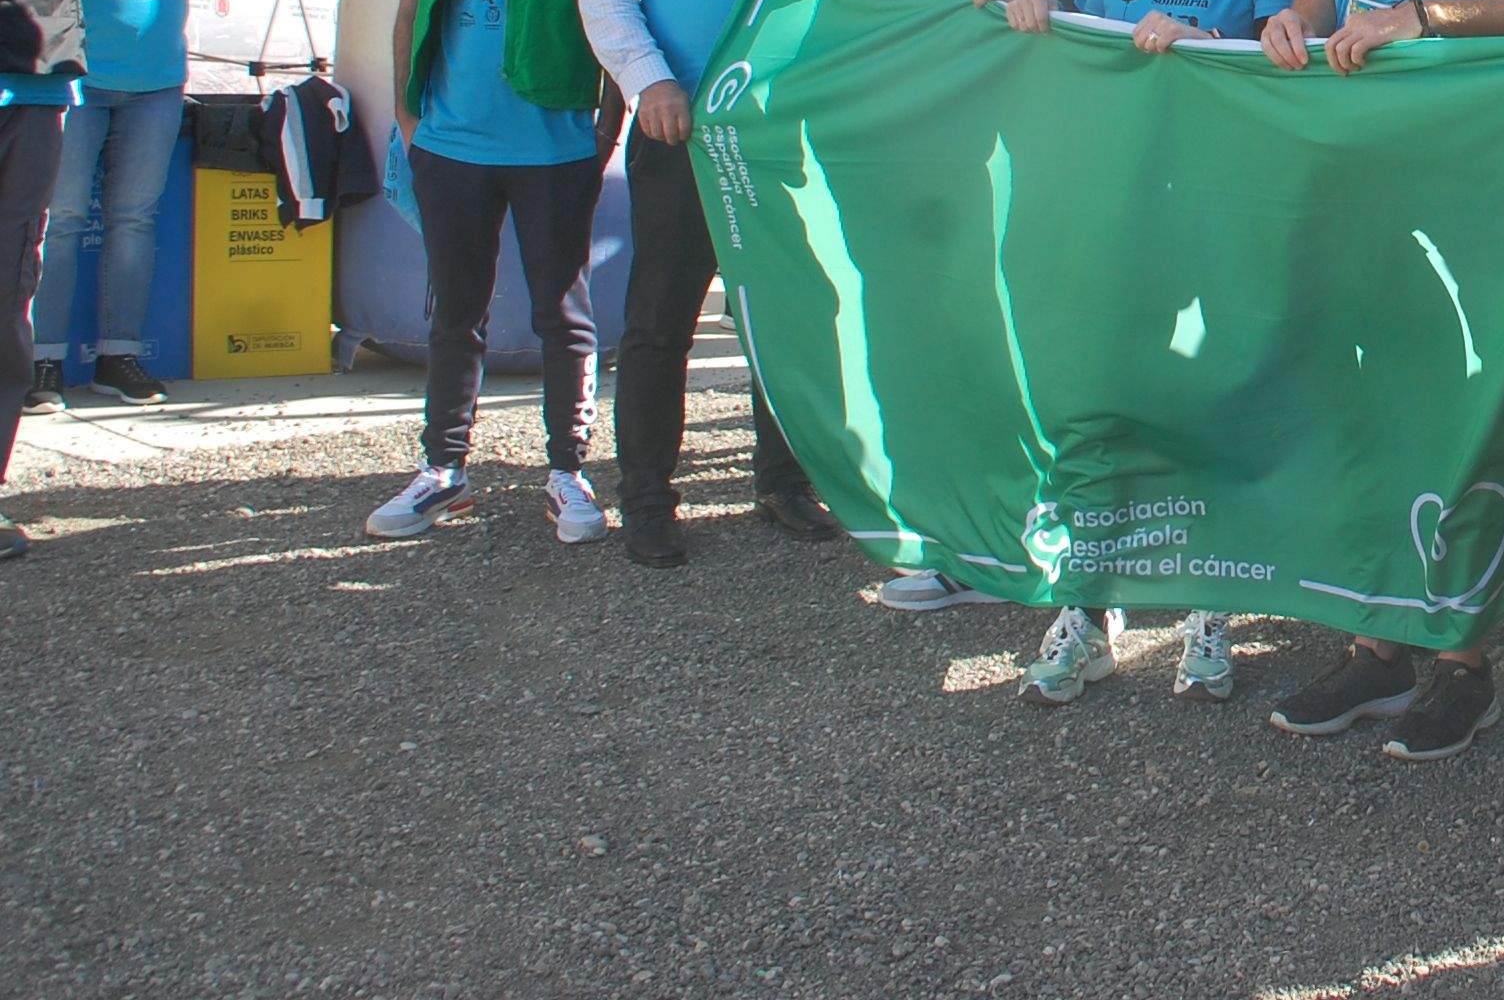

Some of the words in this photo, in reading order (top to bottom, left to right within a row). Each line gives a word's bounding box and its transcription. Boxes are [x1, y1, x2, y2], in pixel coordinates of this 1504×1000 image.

[715, 125, 744, 195] española
[727, 125, 759, 208] asociación
[232, 188, 270, 199] LATAS
[719, 177, 732, 191] el
[231, 209, 268, 221] BRIKS
[723, 194, 743, 250] cáncer
[229, 230, 285, 242] ENVASES
[229, 245, 274, 258] plástico
[1073, 495, 1206, 528] asociación
[1073, 525, 1188, 558] española
[1068, 557, 1152, 576] contra
[1158, 553, 1182, 575] el
[1188, 554, 1276, 581] cáncer
